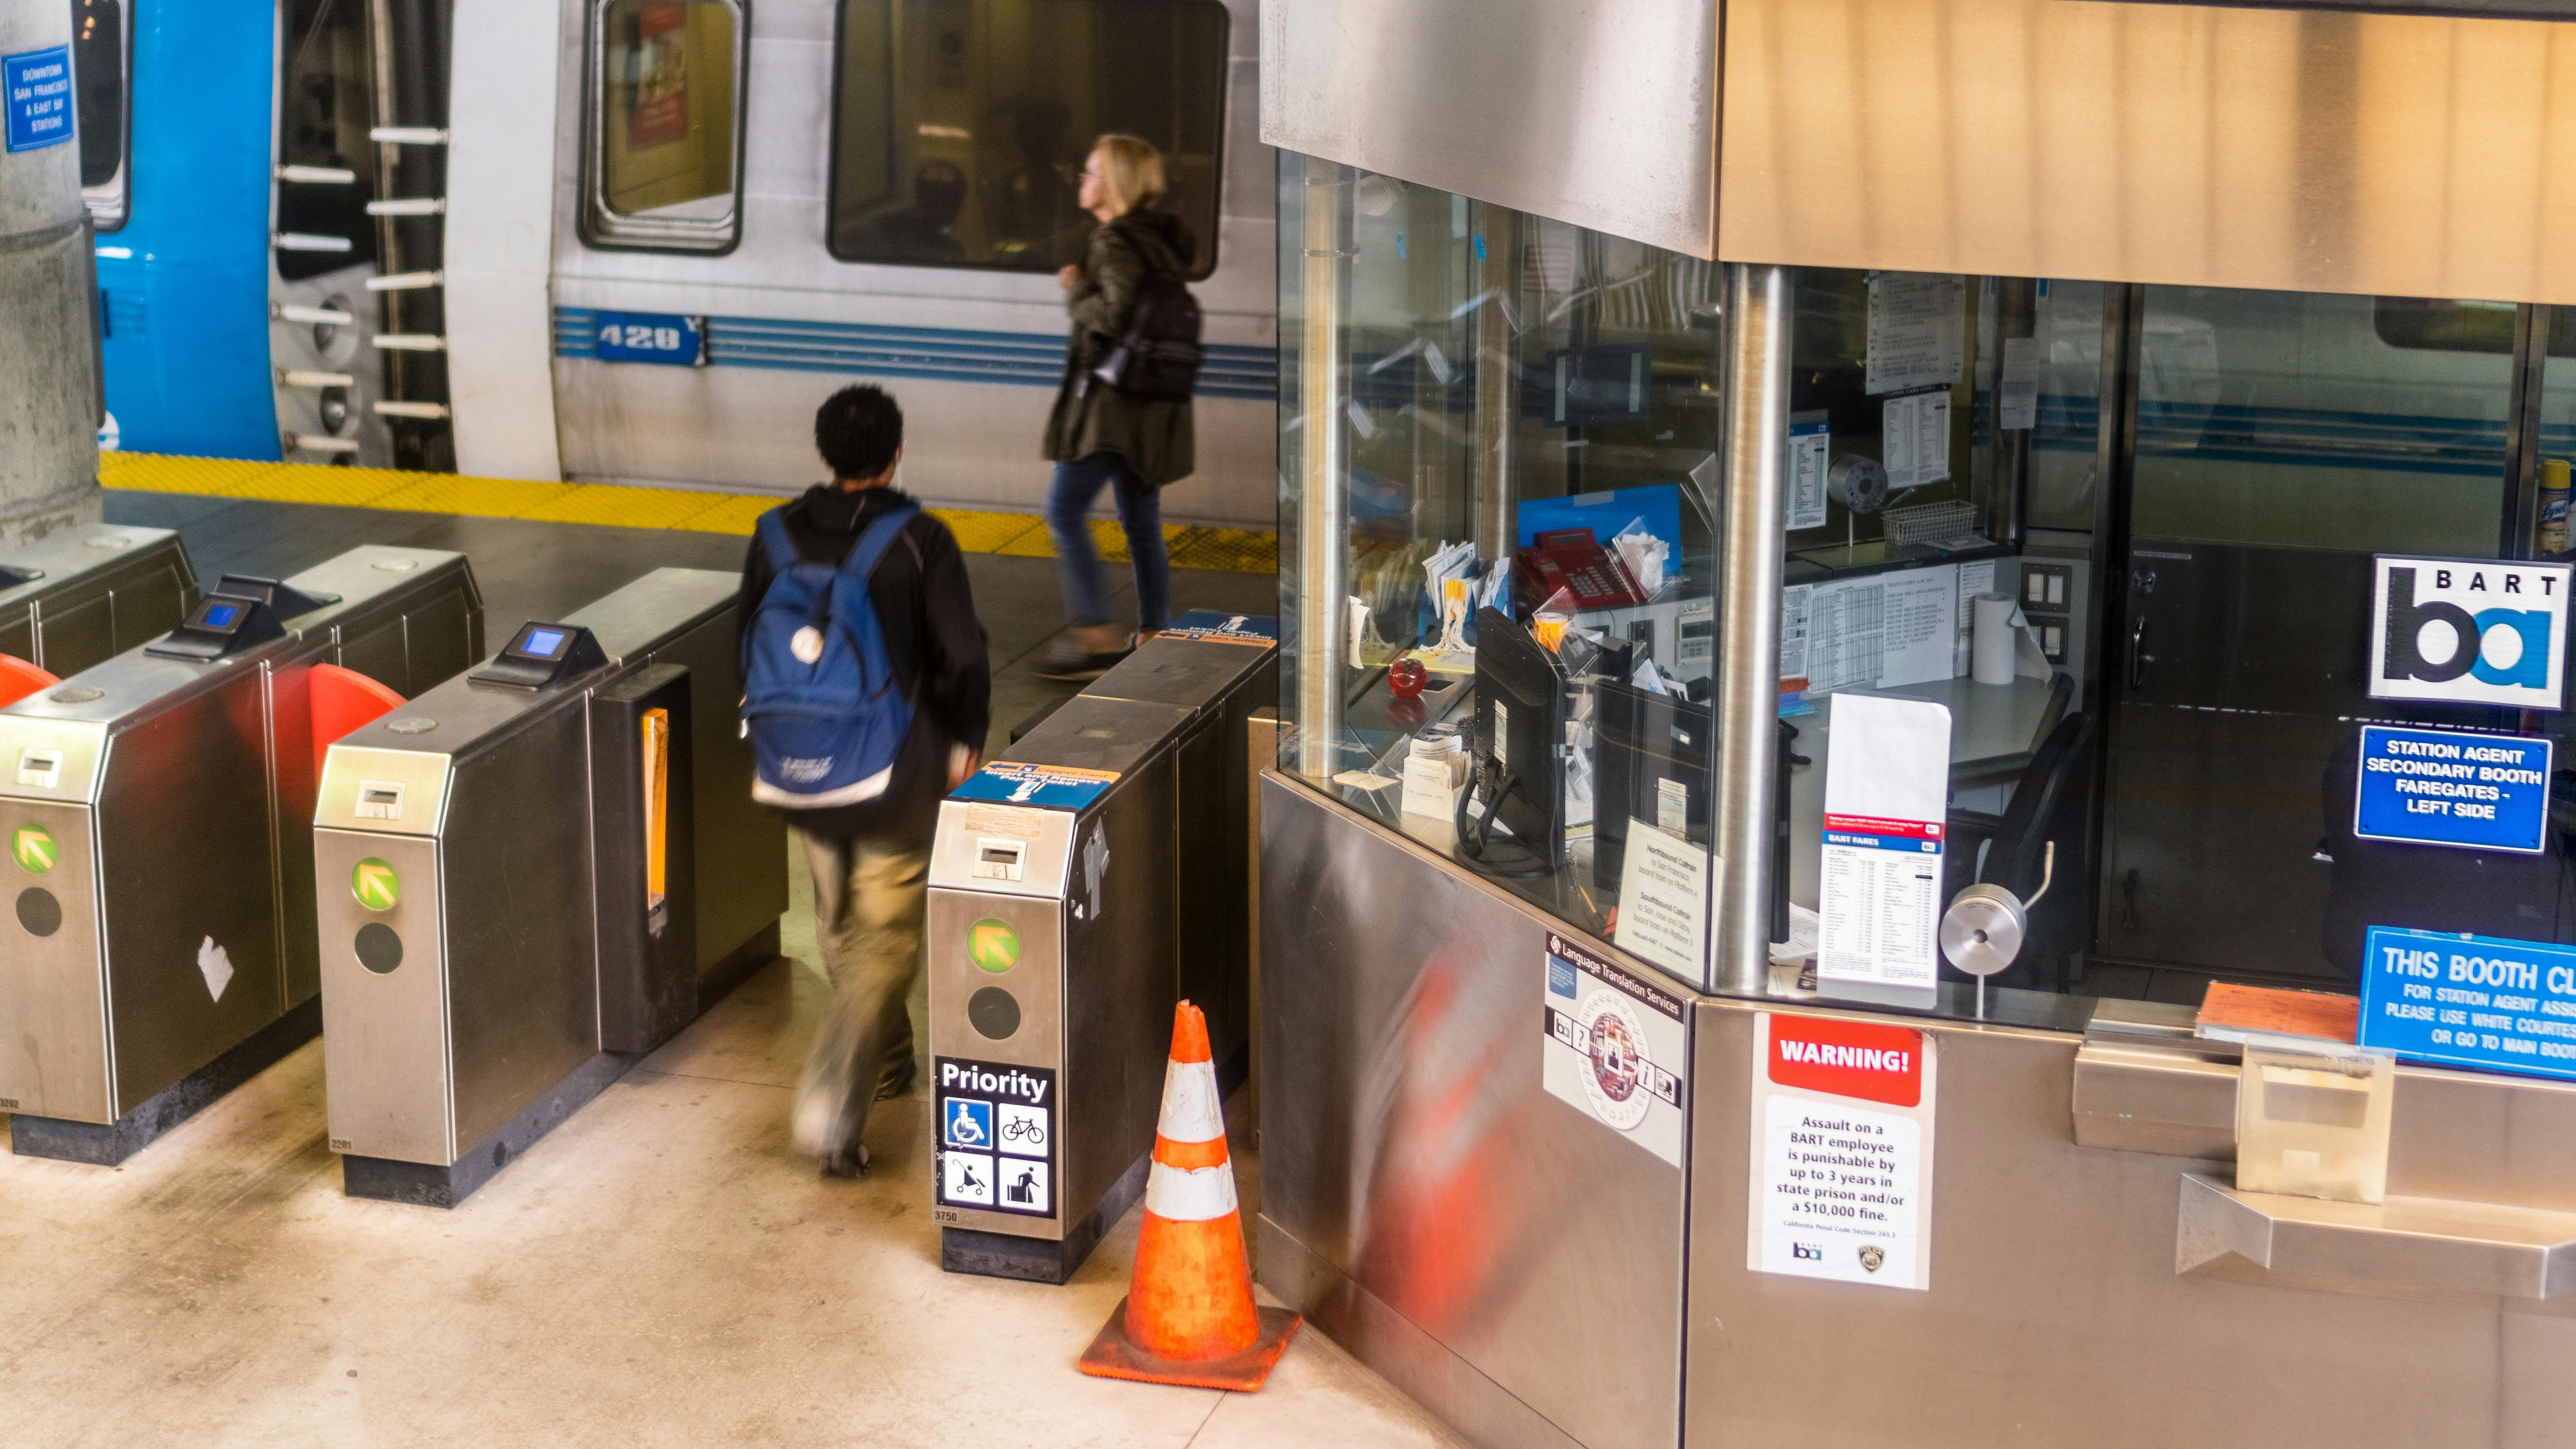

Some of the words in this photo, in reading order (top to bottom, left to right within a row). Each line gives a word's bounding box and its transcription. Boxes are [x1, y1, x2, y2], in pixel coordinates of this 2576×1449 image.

[23, 64, 62, 82] DOWNTOWN
[14, 87, 31, 101] SAN
[34, 78, 68, 96] FRANCISCO
[34, 100, 51, 115] EAST
[31, 115, 62, 133] STATIONS
[2387, 740, 2460, 759] STATION
[2463, 746, 2525, 764] AGENT
[1038, 767, 1076, 776] Clipper
[1052, 774, 1101, 784] Remove
[2366, 758, 2475, 779] SECONDARY
[2479, 767, 2542, 785] BOOTH
[2395, 778, 2499, 800] FAREGATES
[2407, 799, 2451, 816] LEFT
[2454, 802, 2495, 819] SIDE
[1828, 834, 1851, 843] BART
[1853, 837, 1879, 845] FARES
[1647, 844, 1677, 863] Northbound
[1678, 858, 1696, 872] Caltrain
[1657, 860, 1667, 871] San
[1638, 865, 1654, 877] board
[1655, 872, 1666, 883] train
[1675, 880, 1693, 896] Platform
[1640, 891, 1672, 912] Southbound
[1673, 906, 1691, 921] Caltrain
[1644, 905, 1654, 915] San
[1655, 910, 1666, 921] Jose
[1667, 917, 1676, 926] and
[1633, 912, 1648, 925] board
[1650, 920, 1661, 931] train
[1670, 928, 1688, 944] Platform
[1562, 943, 1600, 973] Language
[1602, 964, 1645, 997] Translation
[1647, 988, 1679, 1014] Services
[2383, 947, 2440, 979] THIS
[2449, 955, 2538, 990] BOOTH
[2403, 983, 2432, 1000] FOR
[2435, 987, 2490, 1007] STATION
[2492, 994, 2539, 1012] AGENT
[2385, 1002, 2436, 1021] PLEASE
[2439, 1009, 2467, 1025] USE
[2471, 1013, 2513, 1030] WHITE
[2431, 1028, 2452, 1044] OR
[2455, 1031, 2477, 1048] GO
[2480, 1034, 2500, 1050] TO
[2502, 1037, 2537, 1055] MAIN
[1779, 1039, 1909, 1073] WARNING!
[943, 1063, 1047, 1103] Priority
[1802, 1116, 1850, 1131] Assault
[1855, 1124, 1871, 1133] on
[1875, 1126, 1883, 1135] a
[1790, 1132, 1824, 1145] BART
[1829, 1139, 1894, 1154] employee
[1788, 1148, 1798, 1160] is
[1802, 1152, 1874, 1168] punishable
[1880, 1158, 1895, 1173] by
[1790, 1168, 1806, 1180] up
[1811, 1170, 1824, 1180] to
[1829, 1170, 1835, 1181] 3
[1840, 1174, 1876, 1185] years
[1881, 1175, 1892, 1187] in
[1777, 1183, 1810, 1196] state
[1814, 1187, 1856, 1200] prison
[1860, 1193, 1905, 1206] and/or
[935, 1211, 957, 1222] 3750
[1792, 1202, 1799, 1211] a
[1804, 1201, 1855, 1217] $10,000
[1859, 1207, 1887, 1222] fine.
[1784, 1220, 1814, 1229] California
[1853, 1228, 1876, 1236] Section
[1860, 1247, 1883, 1255] POLICE
